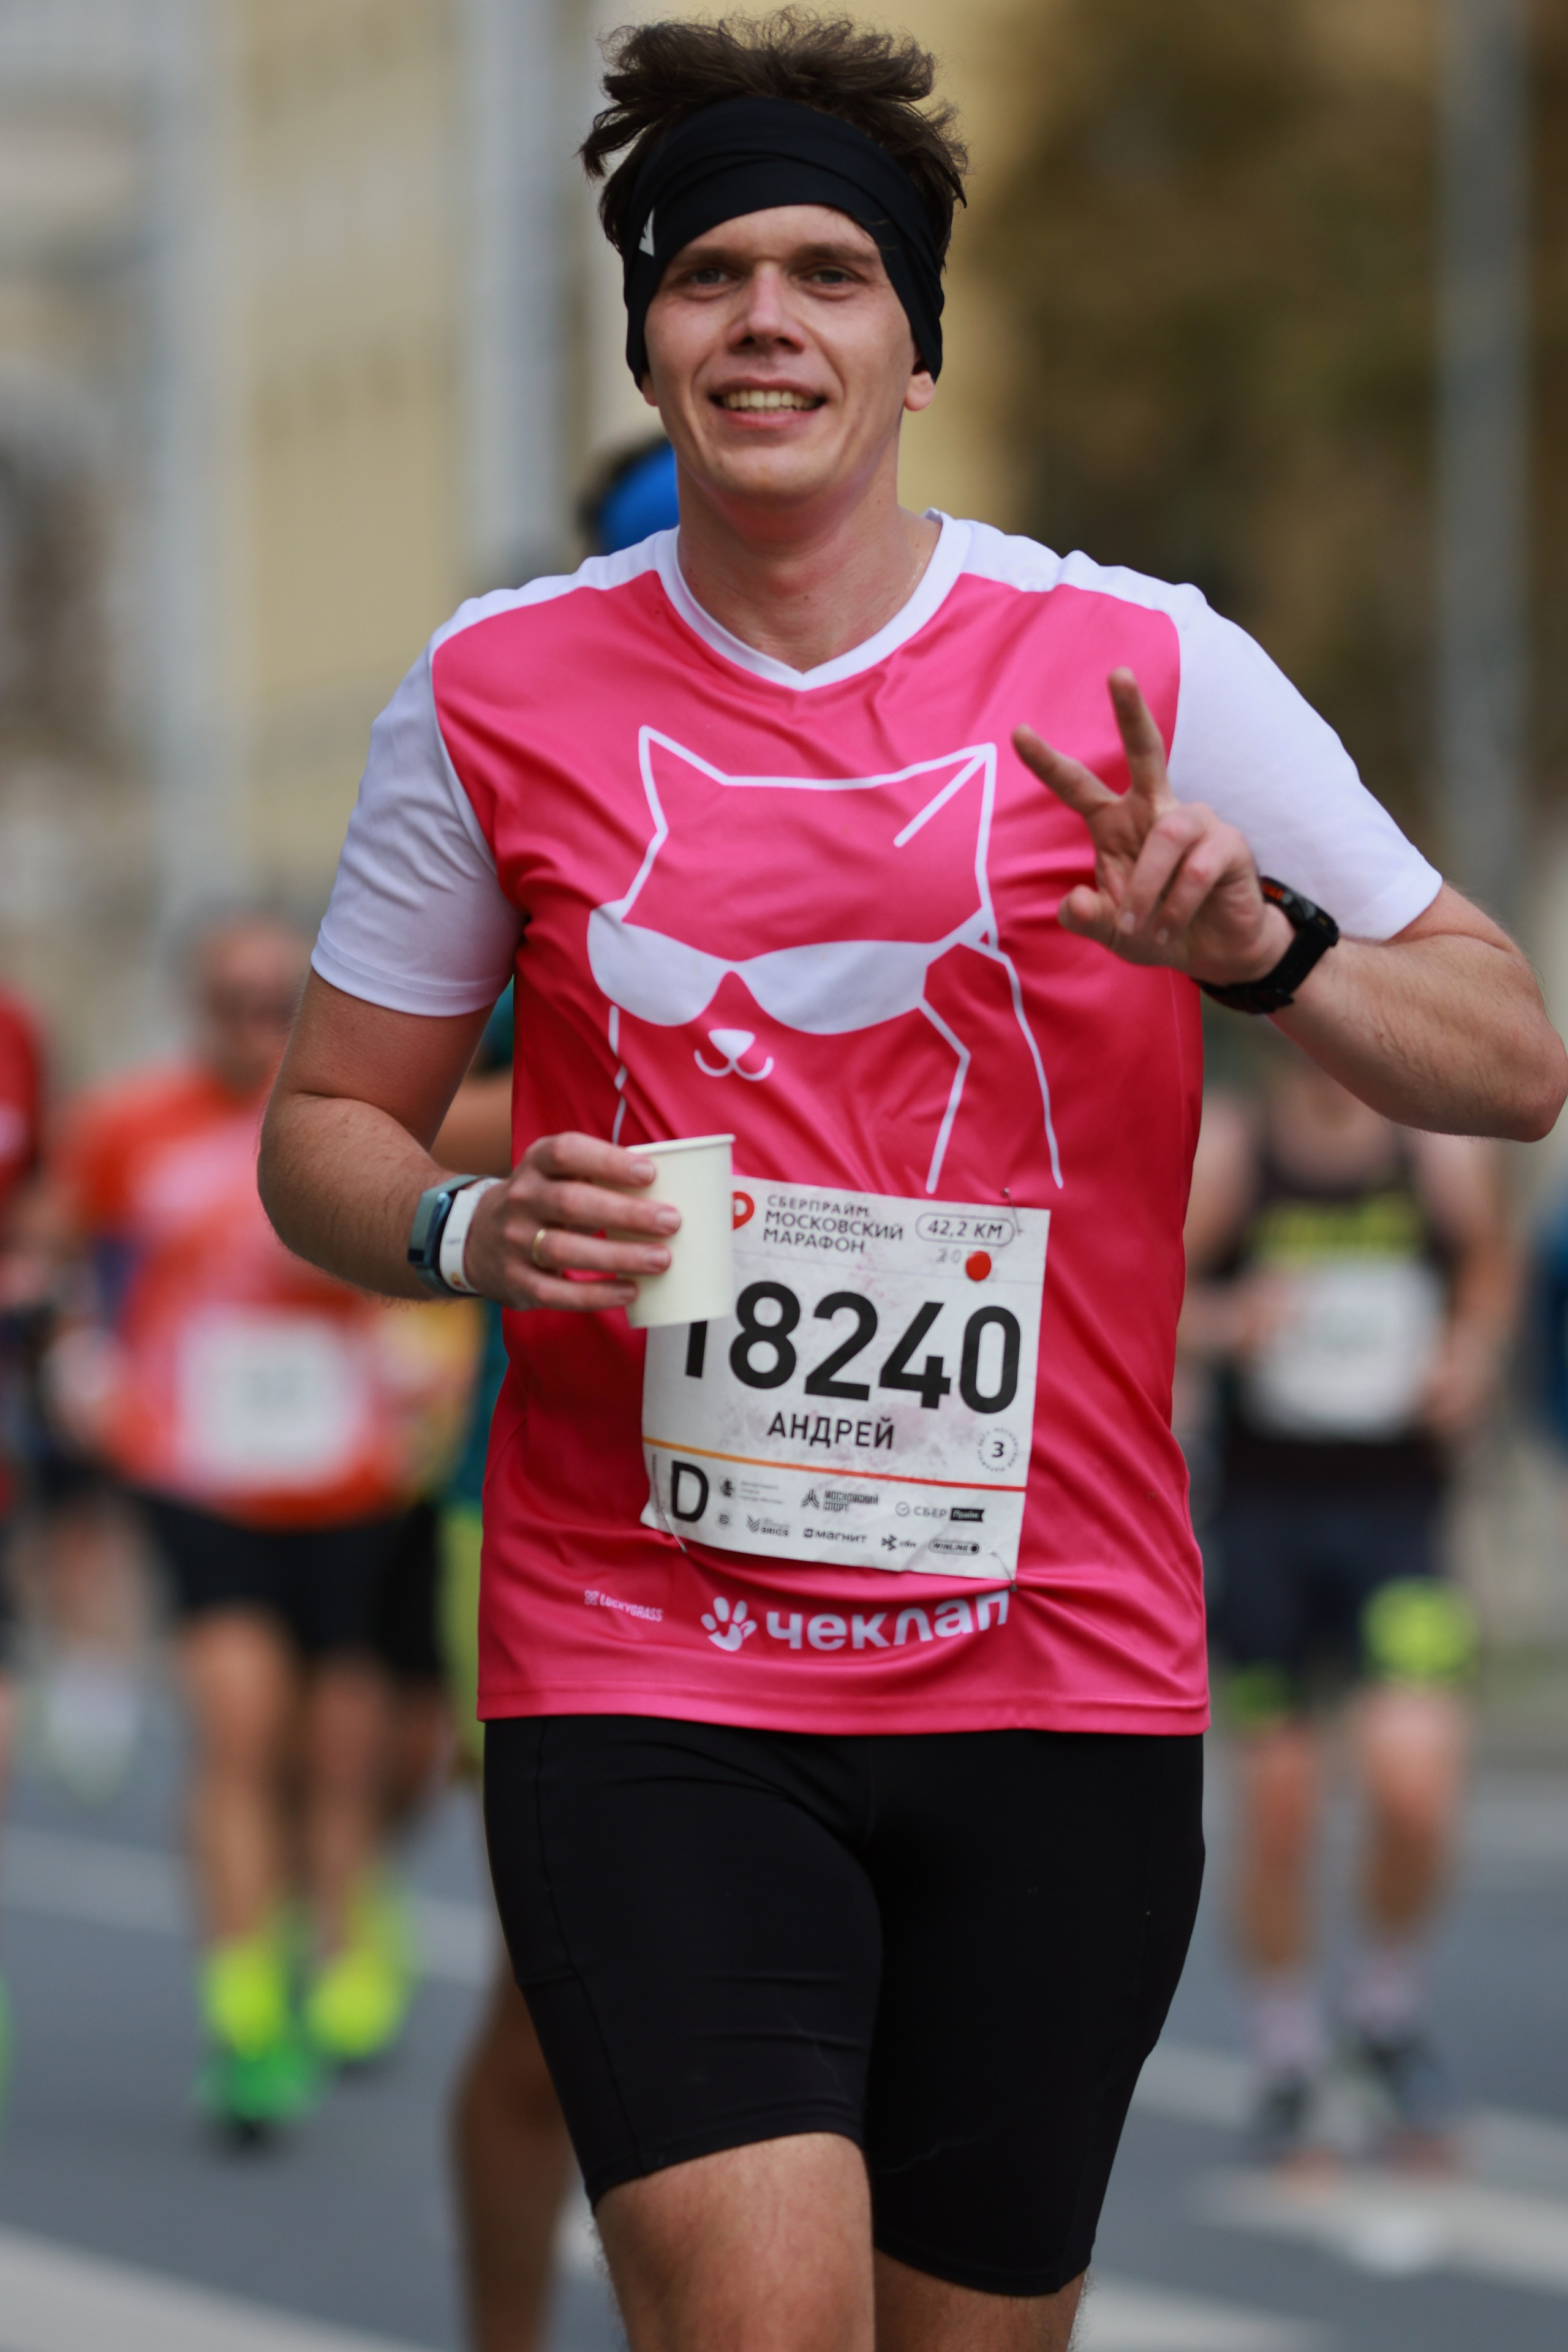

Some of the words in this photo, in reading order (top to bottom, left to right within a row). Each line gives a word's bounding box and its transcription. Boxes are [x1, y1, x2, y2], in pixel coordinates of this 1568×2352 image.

[767, 1194, 869, 1217] СБЕРПРАЙМ
[765, 1210, 904, 1241] МОСКОВСКИЙ
[927, 1220, 967, 1237] 42,2
[974, 1223, 1003, 1239] КМ
[763, 1227, 865, 1254] МАРАФОН
[767, 1412, 895, 1450] АНДРЕЙ
[991, 1441, 1005, 1458] 3
[670, 1460, 709, 1523] D
[824, 1490, 879, 1506] МОСКОВСКИЙ
[913, 1506, 948, 1519] СБЕР
[766, 1589, 1009, 1651] чеклап
